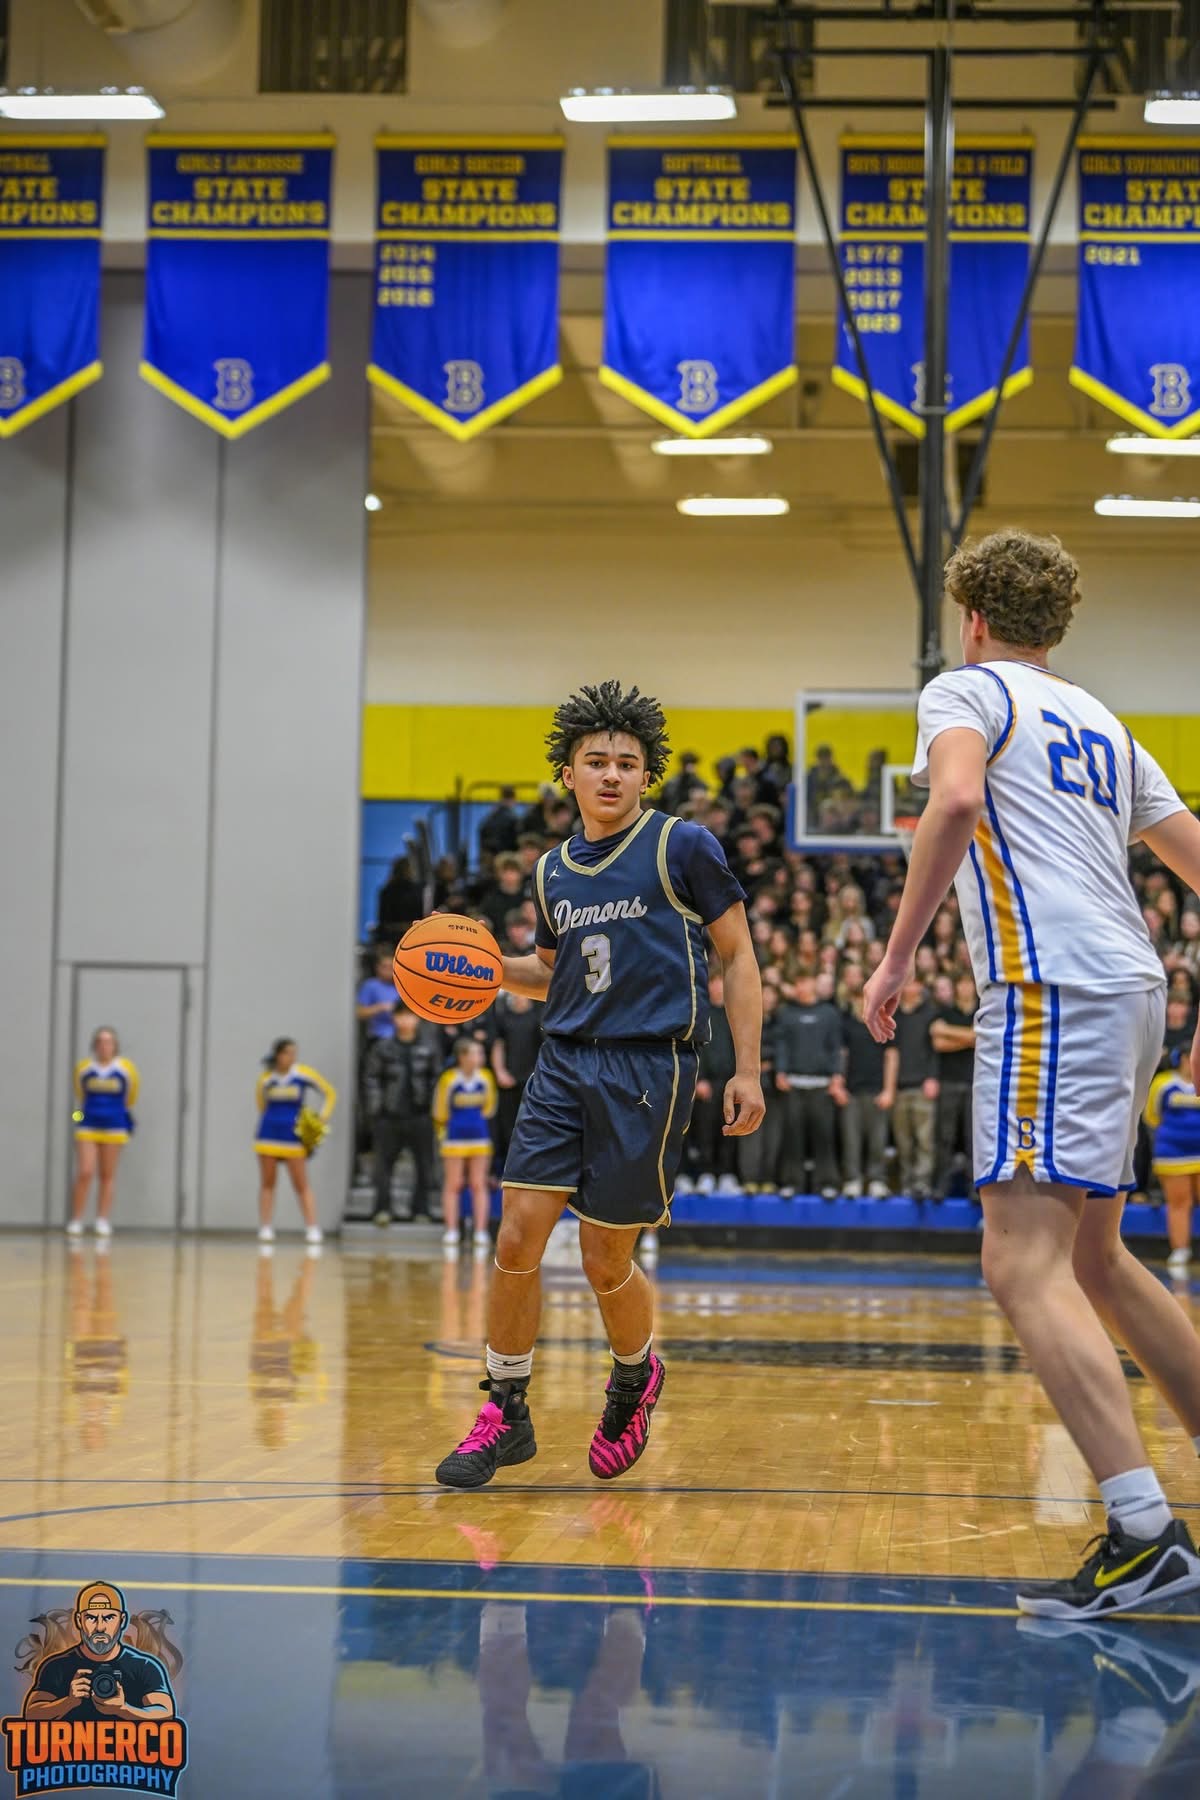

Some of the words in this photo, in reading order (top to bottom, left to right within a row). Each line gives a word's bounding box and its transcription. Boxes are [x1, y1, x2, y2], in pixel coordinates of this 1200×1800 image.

[194, 178, 287, 200] STATE
[422, 178, 518, 201] STATE
[654, 178, 750, 200] STATE
[888, 178, 985, 201] STTE
[152, 201, 326, 225] CHAMPIONS
[381, 201, 556, 226] CHAMPIONS
[612, 201, 791, 226] CHAMPIONS
[846, 201, 1026, 227] CHAMIONS
[213, 357, 255, 411] B
[443, 360, 485, 413] B
[676, 360, 719, 413] B
[1149, 363, 1191, 417] B
[1039, 706, 1120, 817] 20
[553, 895, 648, 935] Demons
[425, 951, 495, 982] Wilson
[580, 933, 612, 994] 3
[429, 993, 475, 1012] EVO
[1016, 1117, 1038, 1150] B
